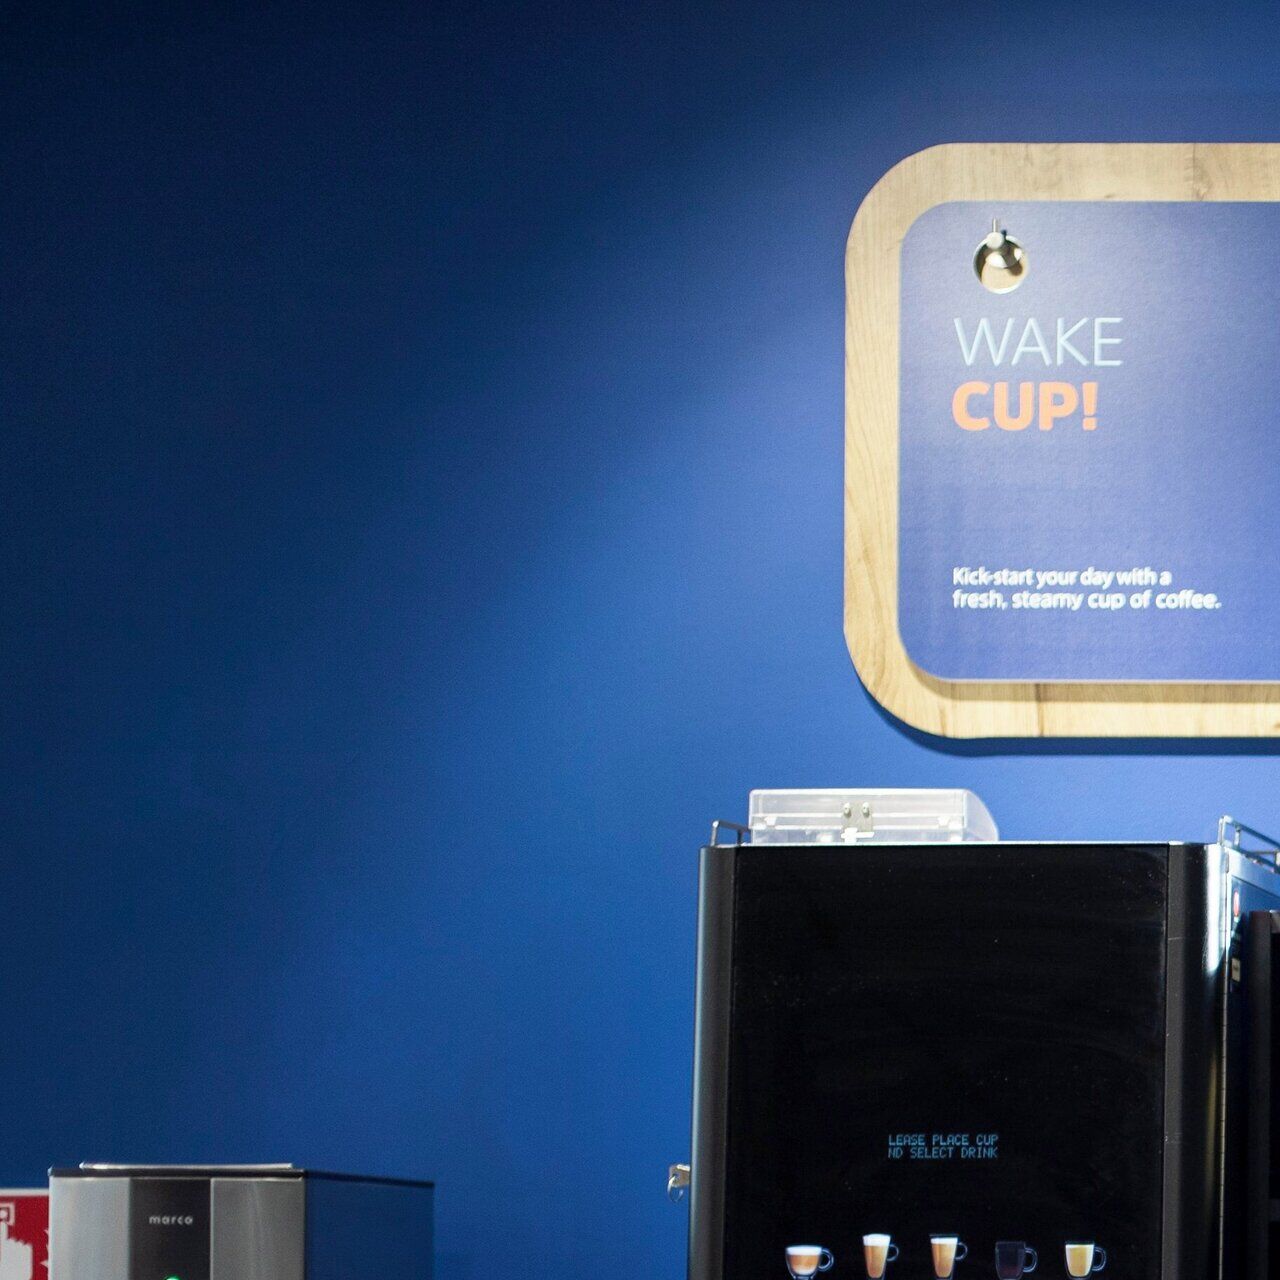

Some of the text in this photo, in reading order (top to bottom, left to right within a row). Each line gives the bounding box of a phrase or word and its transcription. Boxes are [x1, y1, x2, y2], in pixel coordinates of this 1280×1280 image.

[953, 317, 1123, 367] WAKE
[952, 381, 1098, 431] CUP!
[953, 567, 1172, 589] Kick-start your day with a
[953, 589, 1221, 610] fresh, steamy cup of coffee.
[888, 1134, 999, 1146] LEASE PLACE CUP
[888, 1147, 998, 1158] ND SELECT DRINK
[149, 1215, 193, 1225] marco
